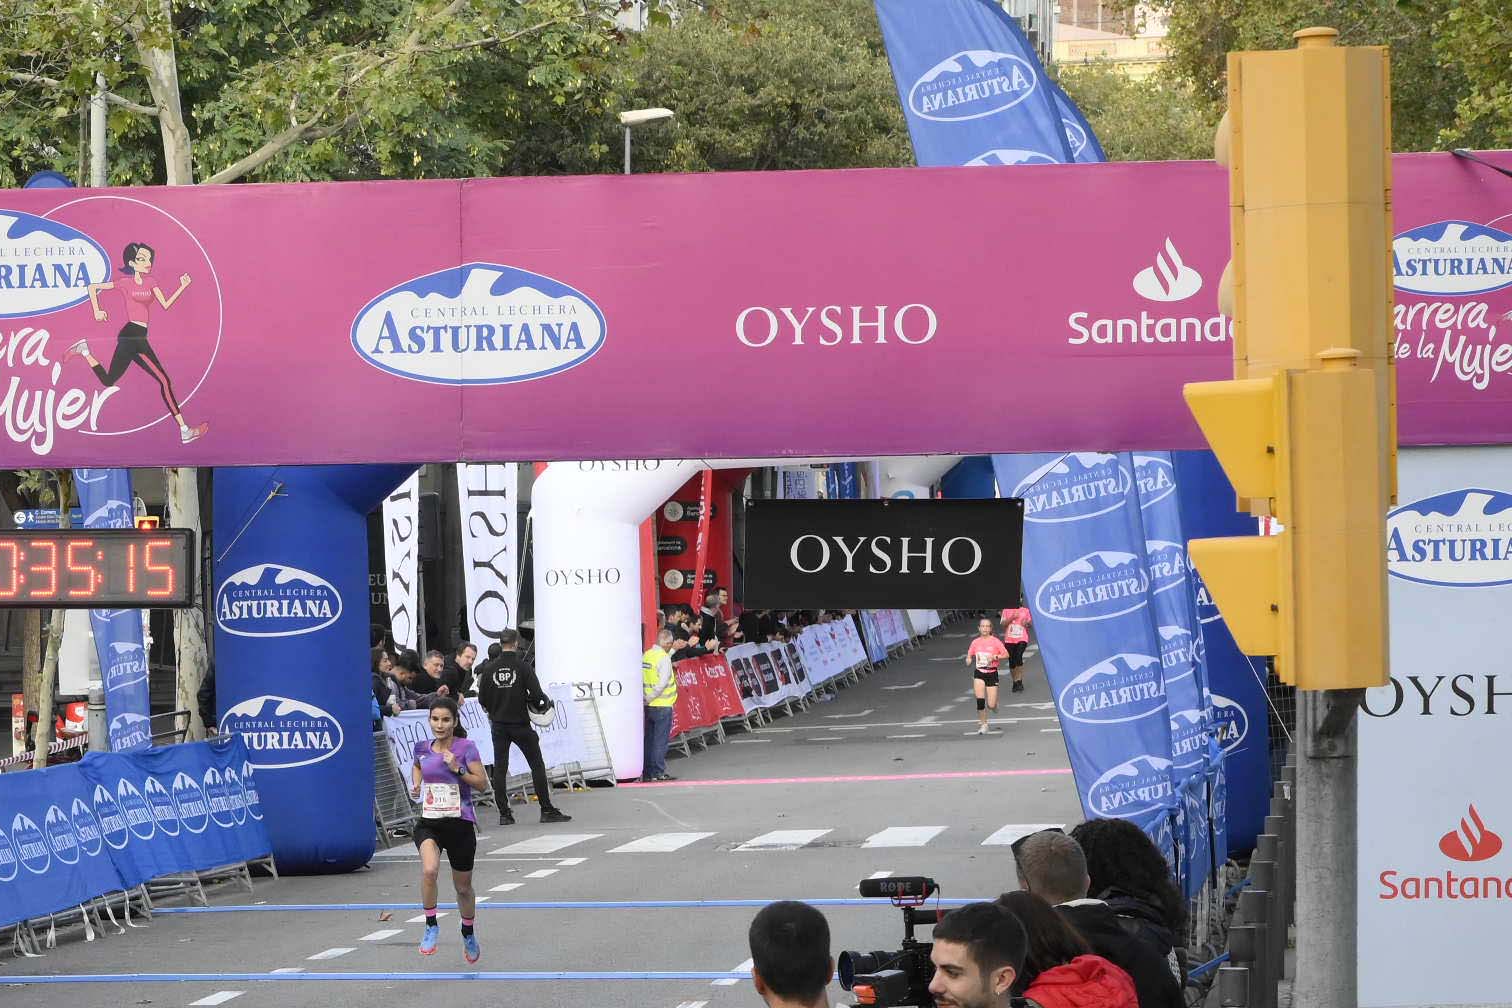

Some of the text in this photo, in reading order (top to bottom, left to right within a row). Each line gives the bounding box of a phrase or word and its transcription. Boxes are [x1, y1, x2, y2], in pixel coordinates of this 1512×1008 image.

[13, 246, 86, 257] LECHERA
[1408, 246, 1459, 255] CENTRAL
[410, 304, 577, 319] CENTRAL LECHERA
[735, 303, 937, 347] OYSHO
[1394, 301, 1488, 330] arrera
[371, 310, 586, 354] ASTURIANA
[1067, 310, 1235, 345] Santand
[1417, 332, 1435, 359] la
[1430, 325, 1512, 390] Muje
[1414, 523, 1479, 534] CENTRAL
[789, 534, 983, 576] OYSHO
[1388, 526, 1512, 562] ASTURIA
[545, 567, 621, 586] OYSHO
[232, 587, 328, 598] CENTRAL LECHERA
[219, 593, 333, 621] ASTURIANA
[498, 672, 511, 682] BP
[1359, 673, 1512, 718] OYSH
[234, 720, 328, 729] CENTRAL LECHERA
